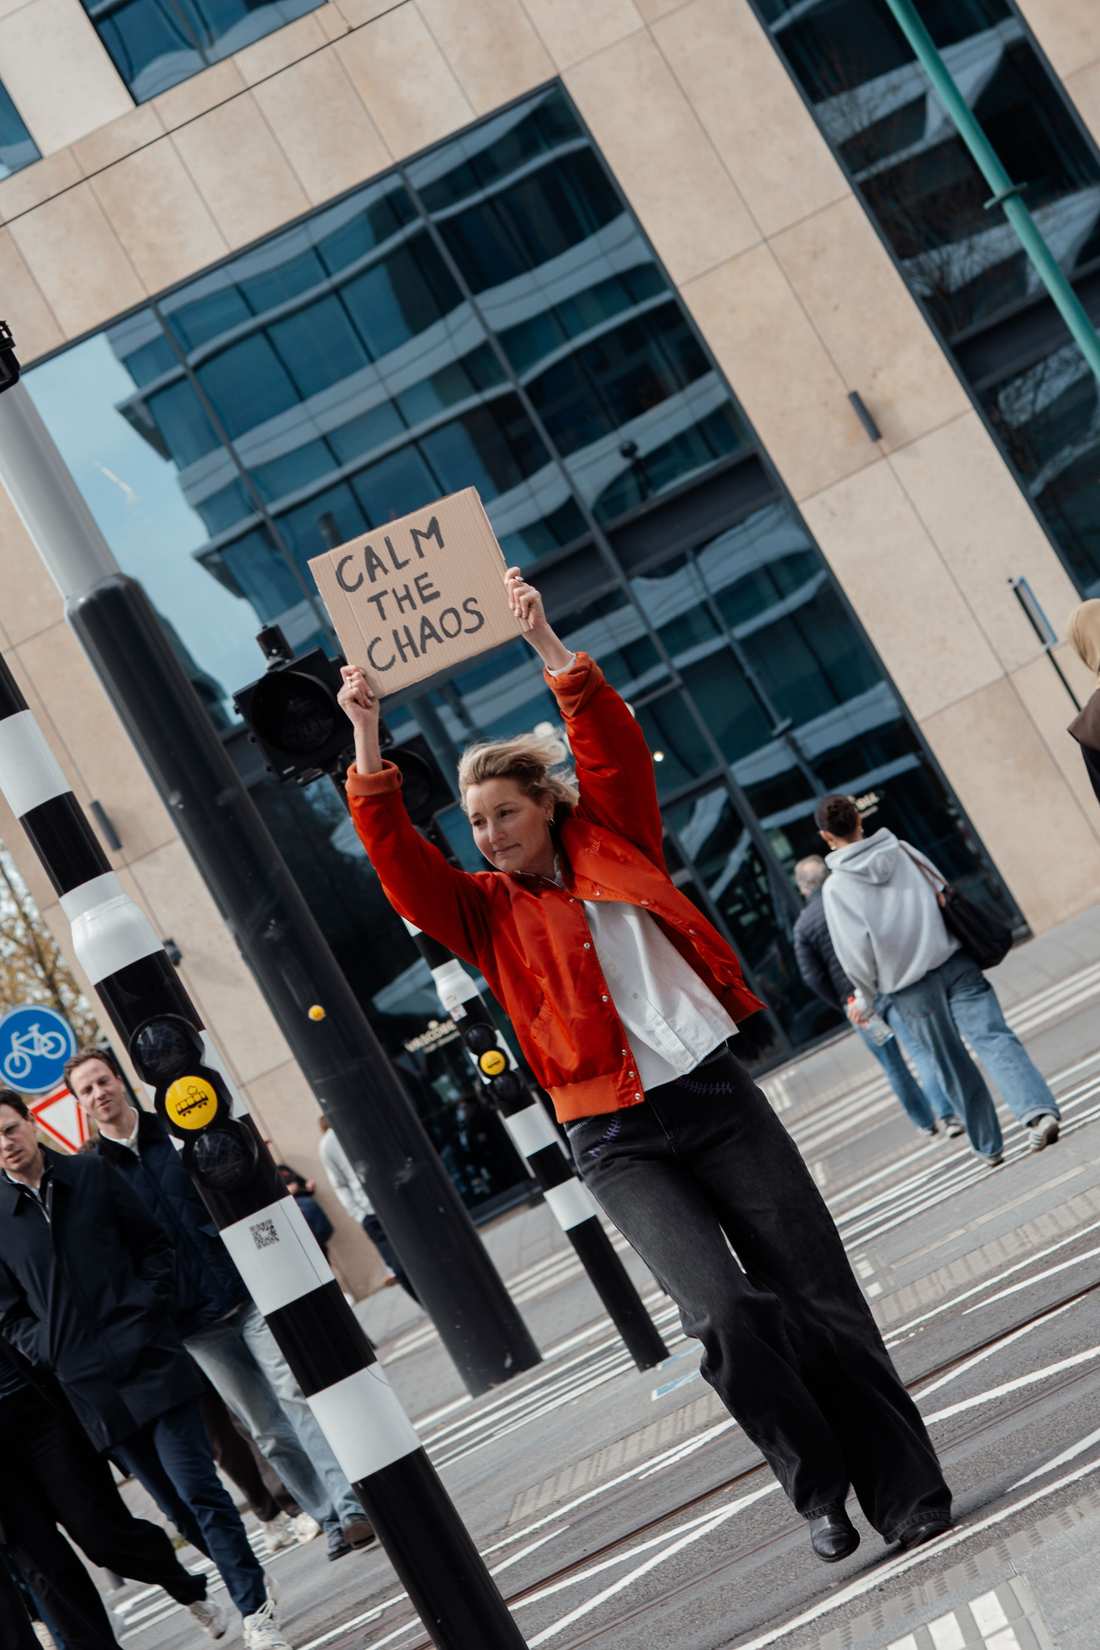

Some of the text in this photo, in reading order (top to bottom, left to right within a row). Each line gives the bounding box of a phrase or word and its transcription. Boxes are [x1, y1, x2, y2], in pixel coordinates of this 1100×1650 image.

[335, 516, 445, 593] CALM
[367, 572, 441, 621] THE
[367, 597, 486, 672] CHAOS
